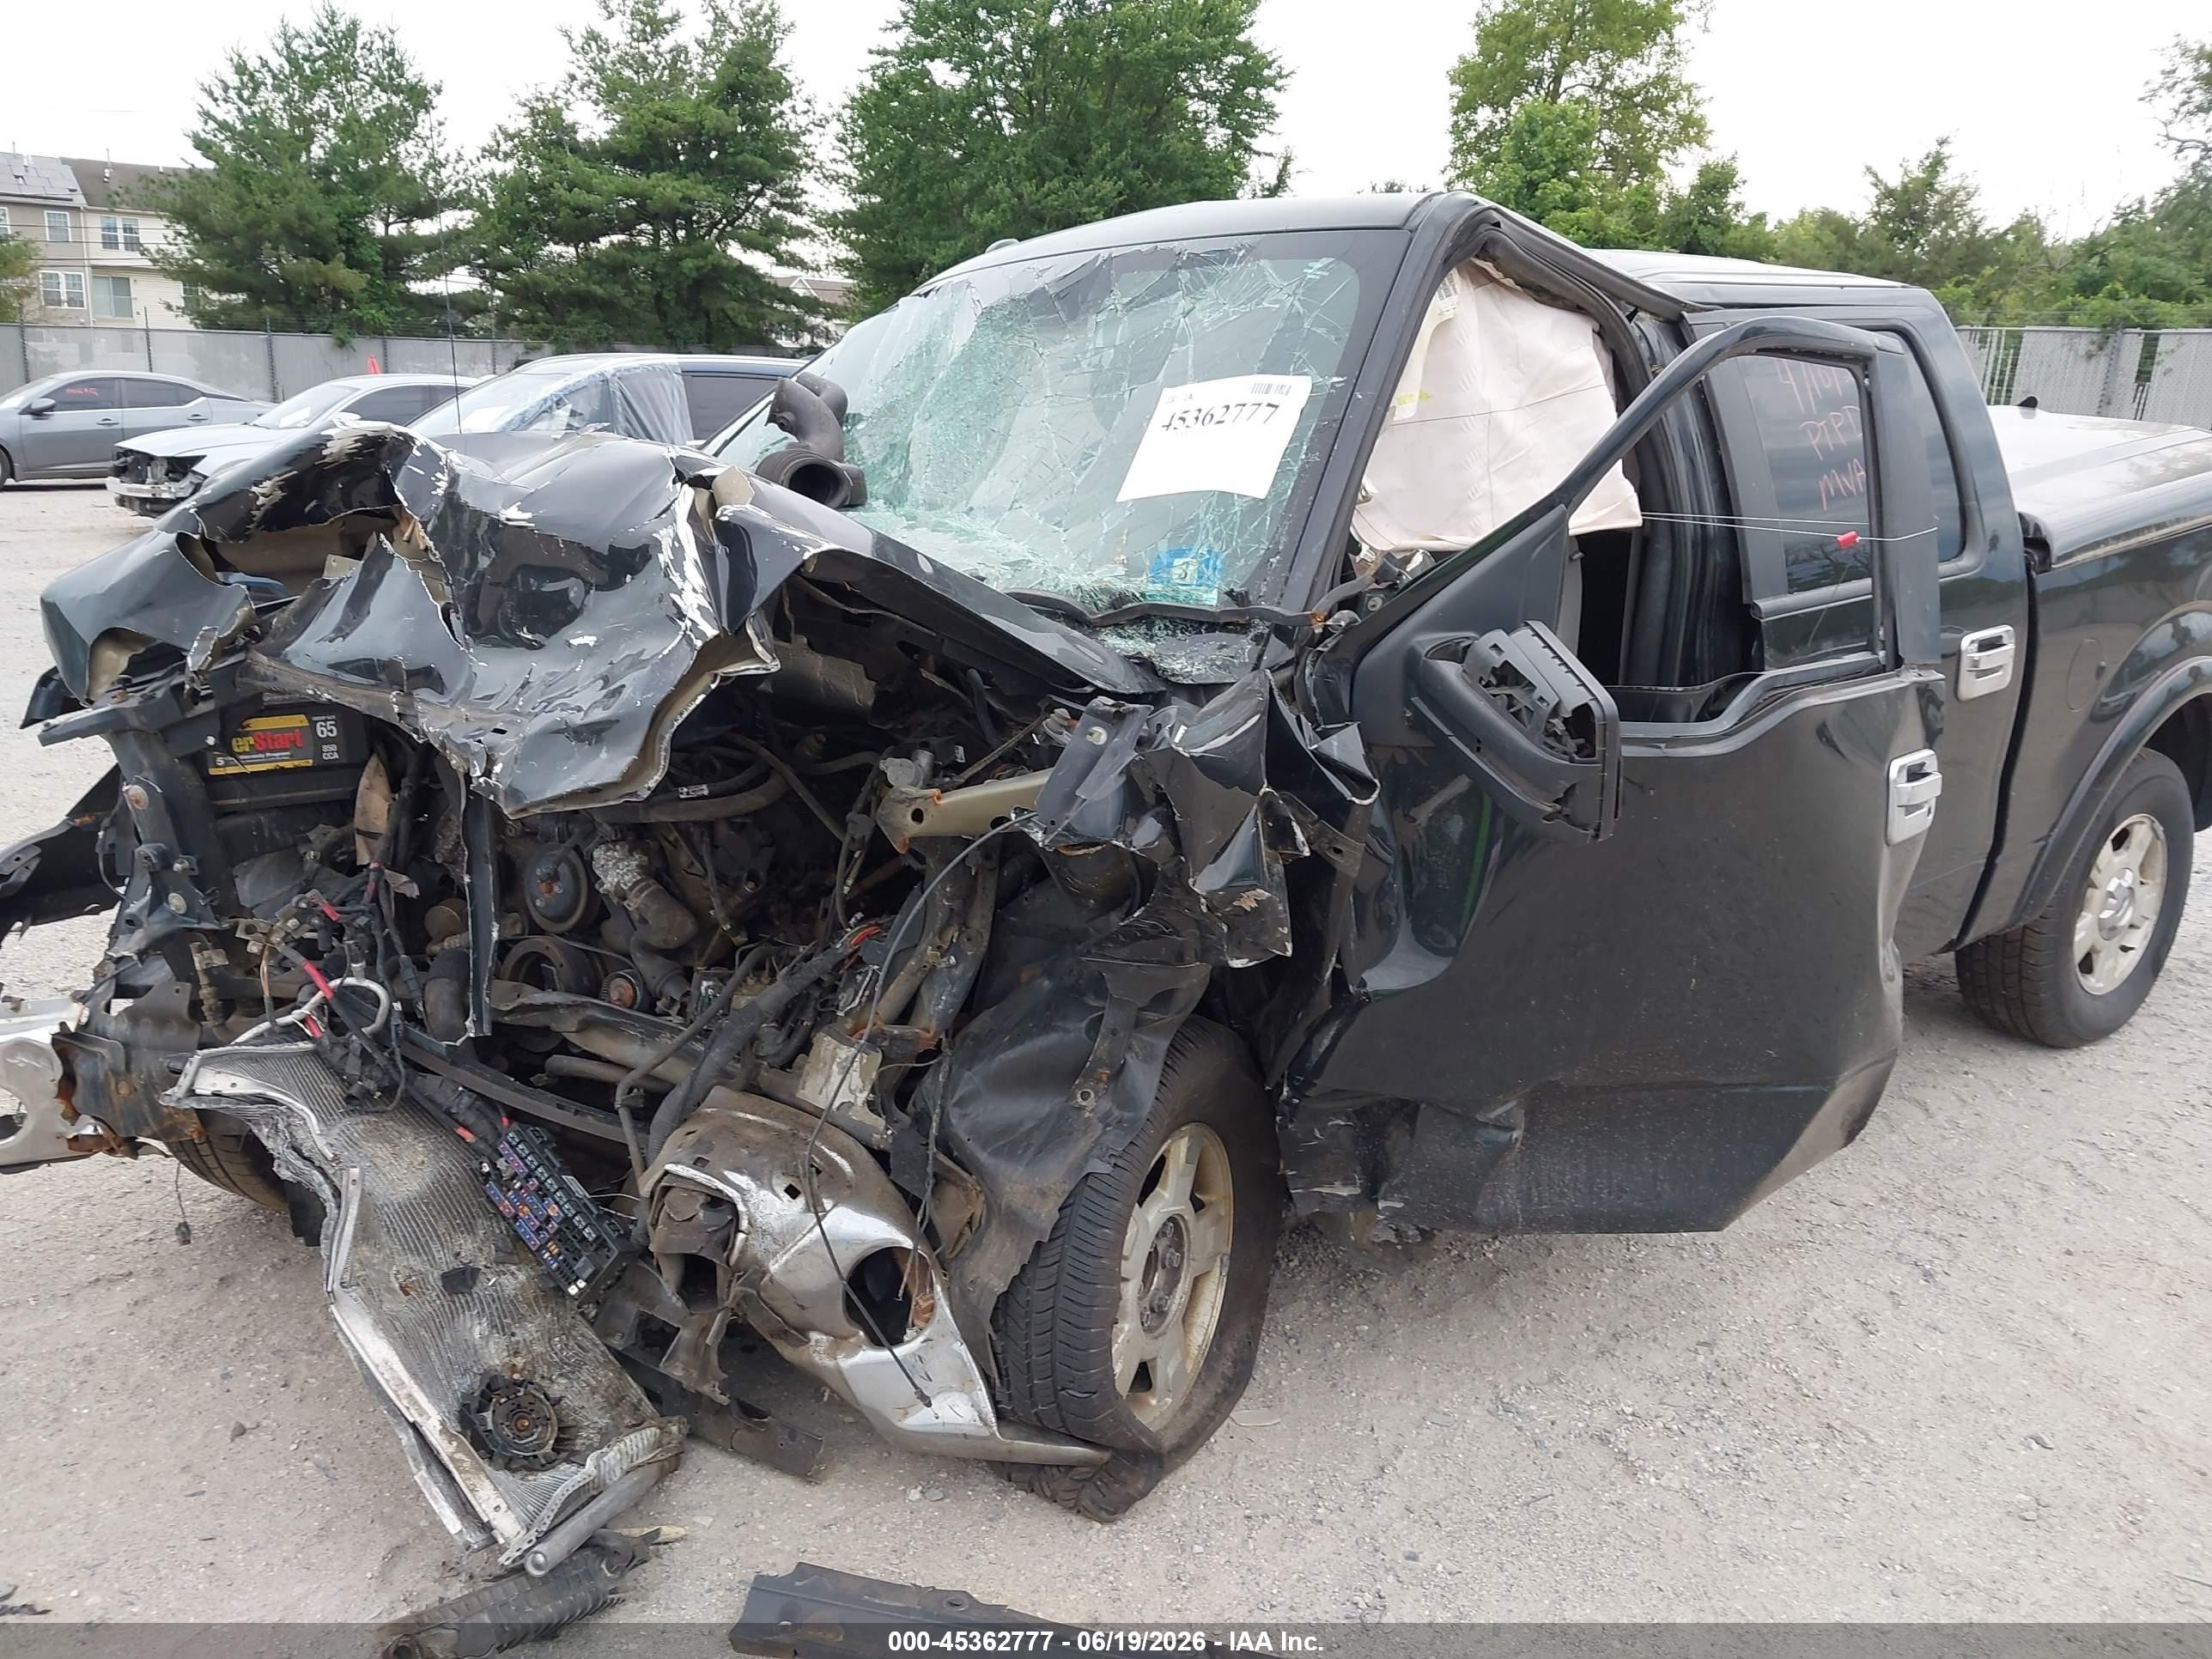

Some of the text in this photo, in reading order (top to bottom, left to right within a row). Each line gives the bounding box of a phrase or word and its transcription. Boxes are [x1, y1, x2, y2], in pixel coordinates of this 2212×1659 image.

[1161, 401, 1280, 432] 45362777
[232, 729, 303, 753] erStart
[315, 720, 337, 738] 65
